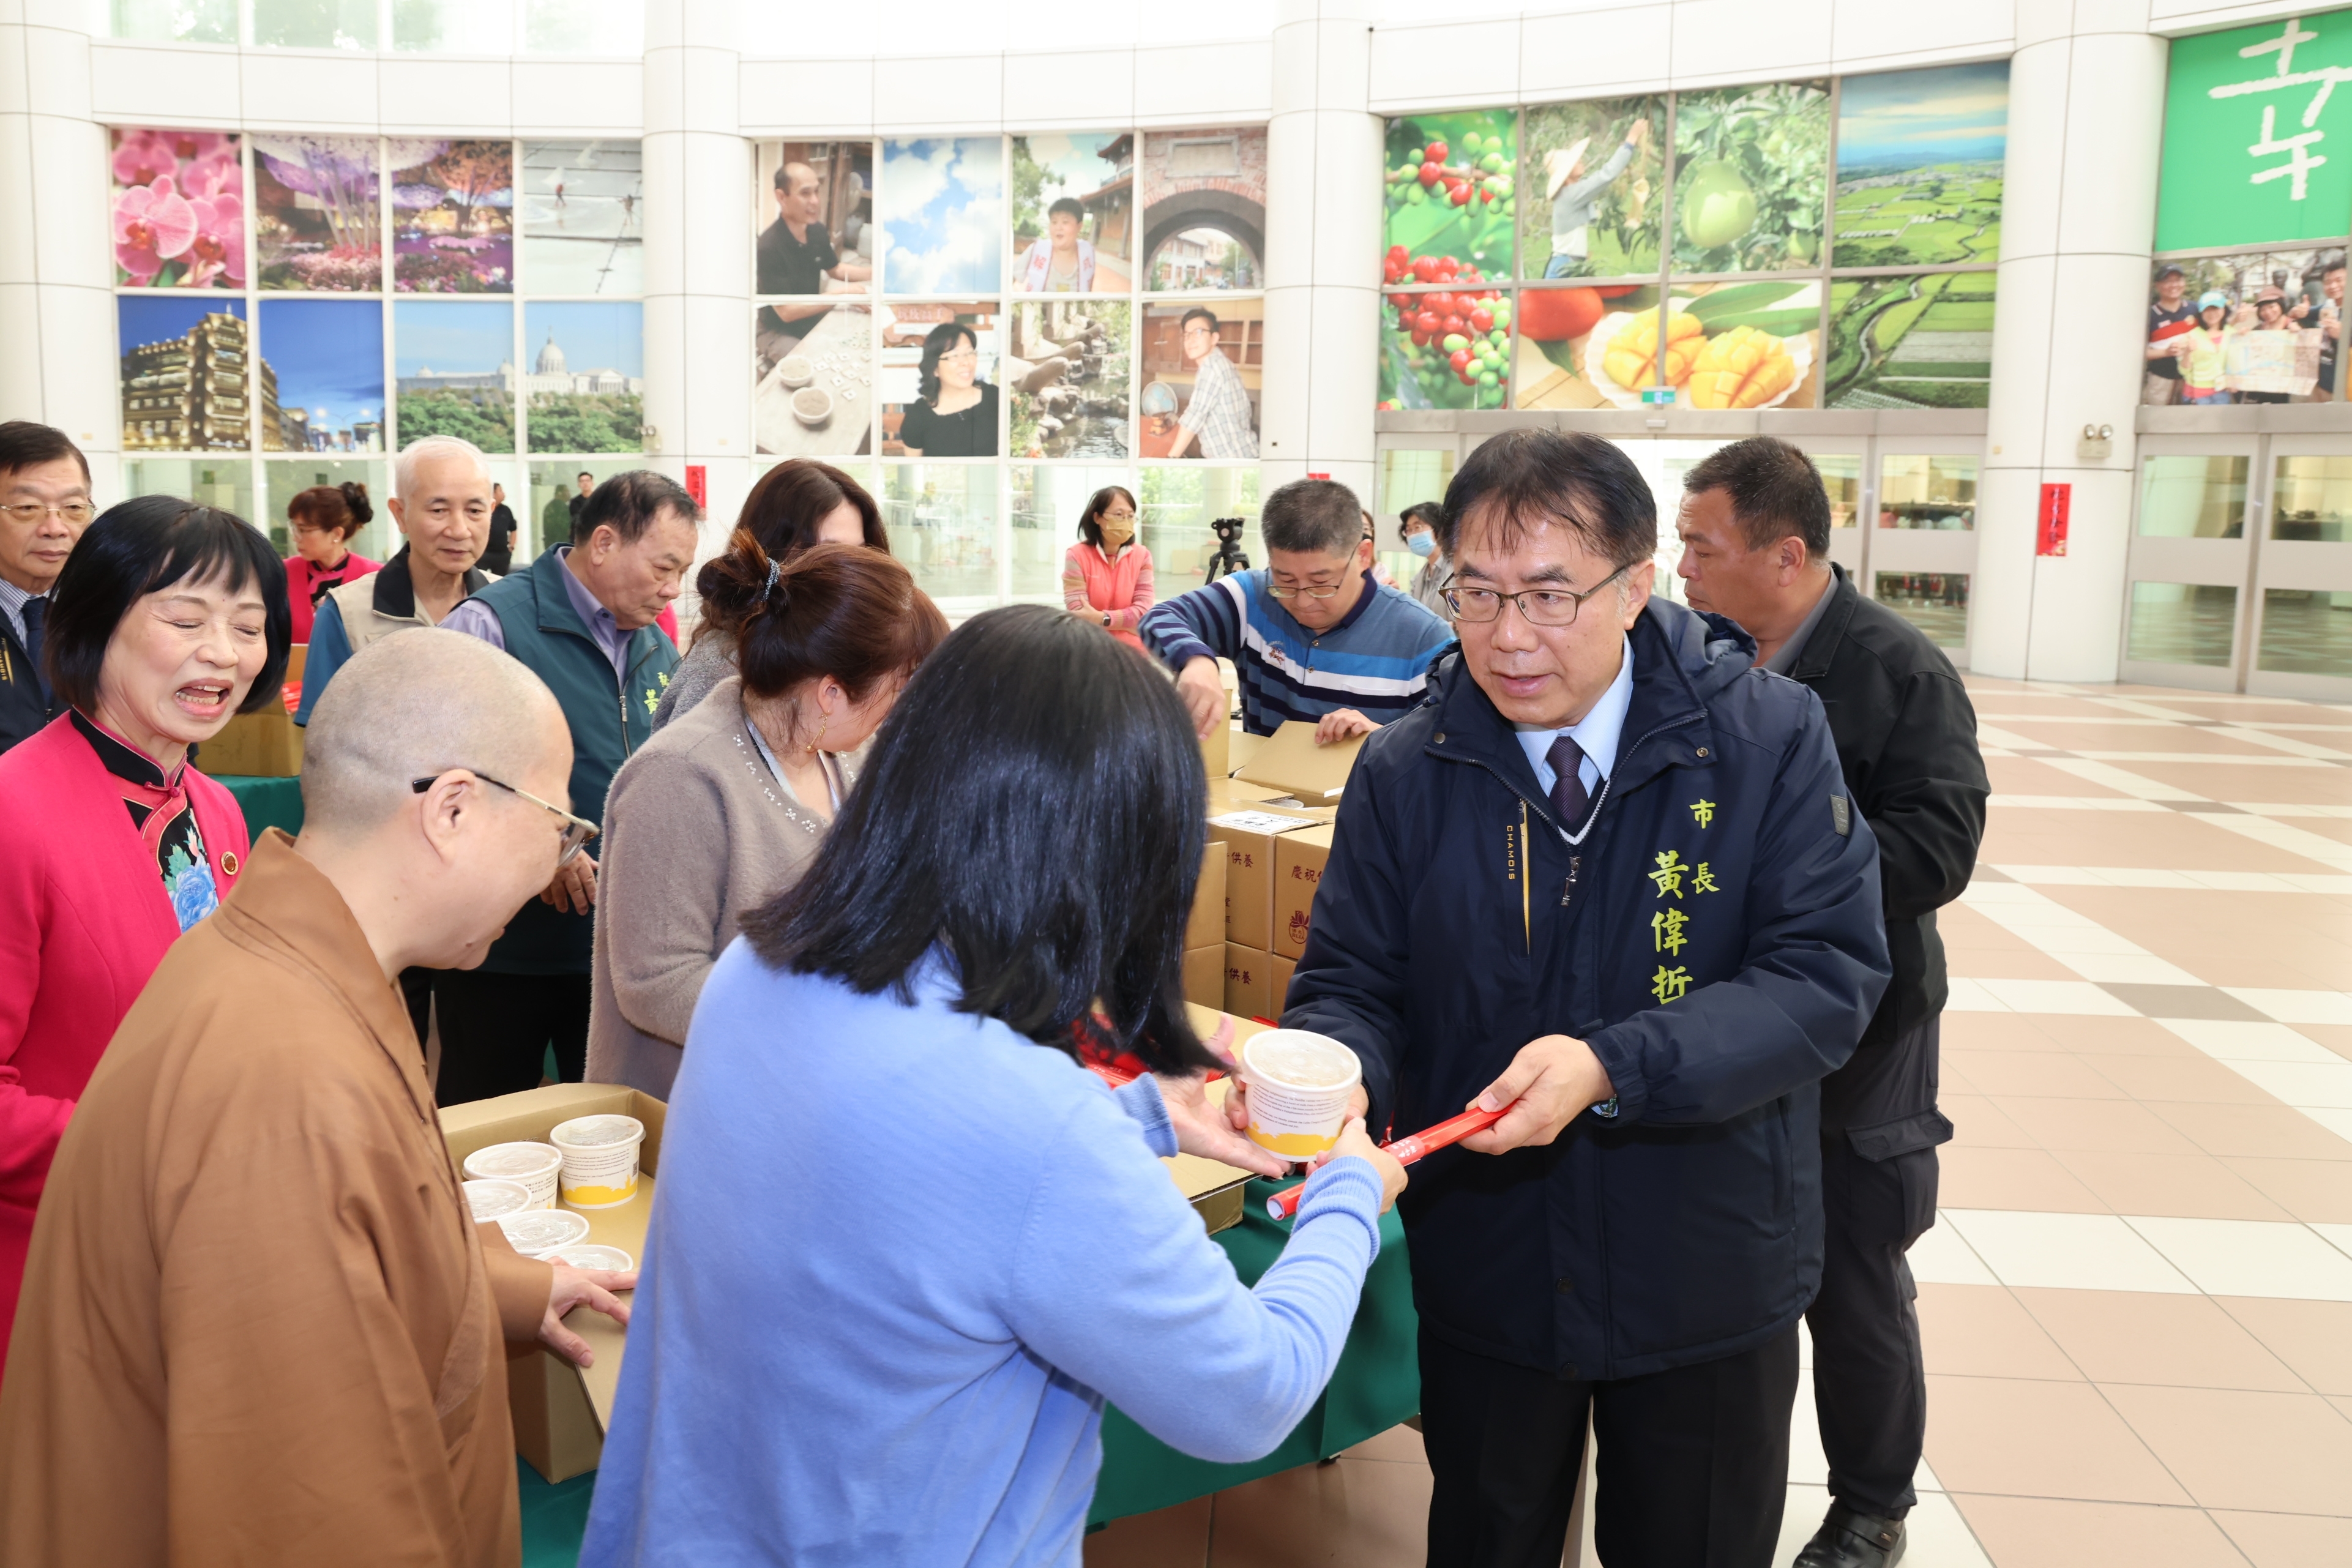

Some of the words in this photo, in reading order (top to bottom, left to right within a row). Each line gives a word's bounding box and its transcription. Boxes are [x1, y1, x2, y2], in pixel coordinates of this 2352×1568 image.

[1227, 851, 1253, 868] 供養
[1506, 825, 1516, 880] CHAMOIS
[1689, 798, 1720, 895] 市長
[1648, 849, 1693, 1004] 黃偉哲
[1225, 968, 1252, 985] 供養
